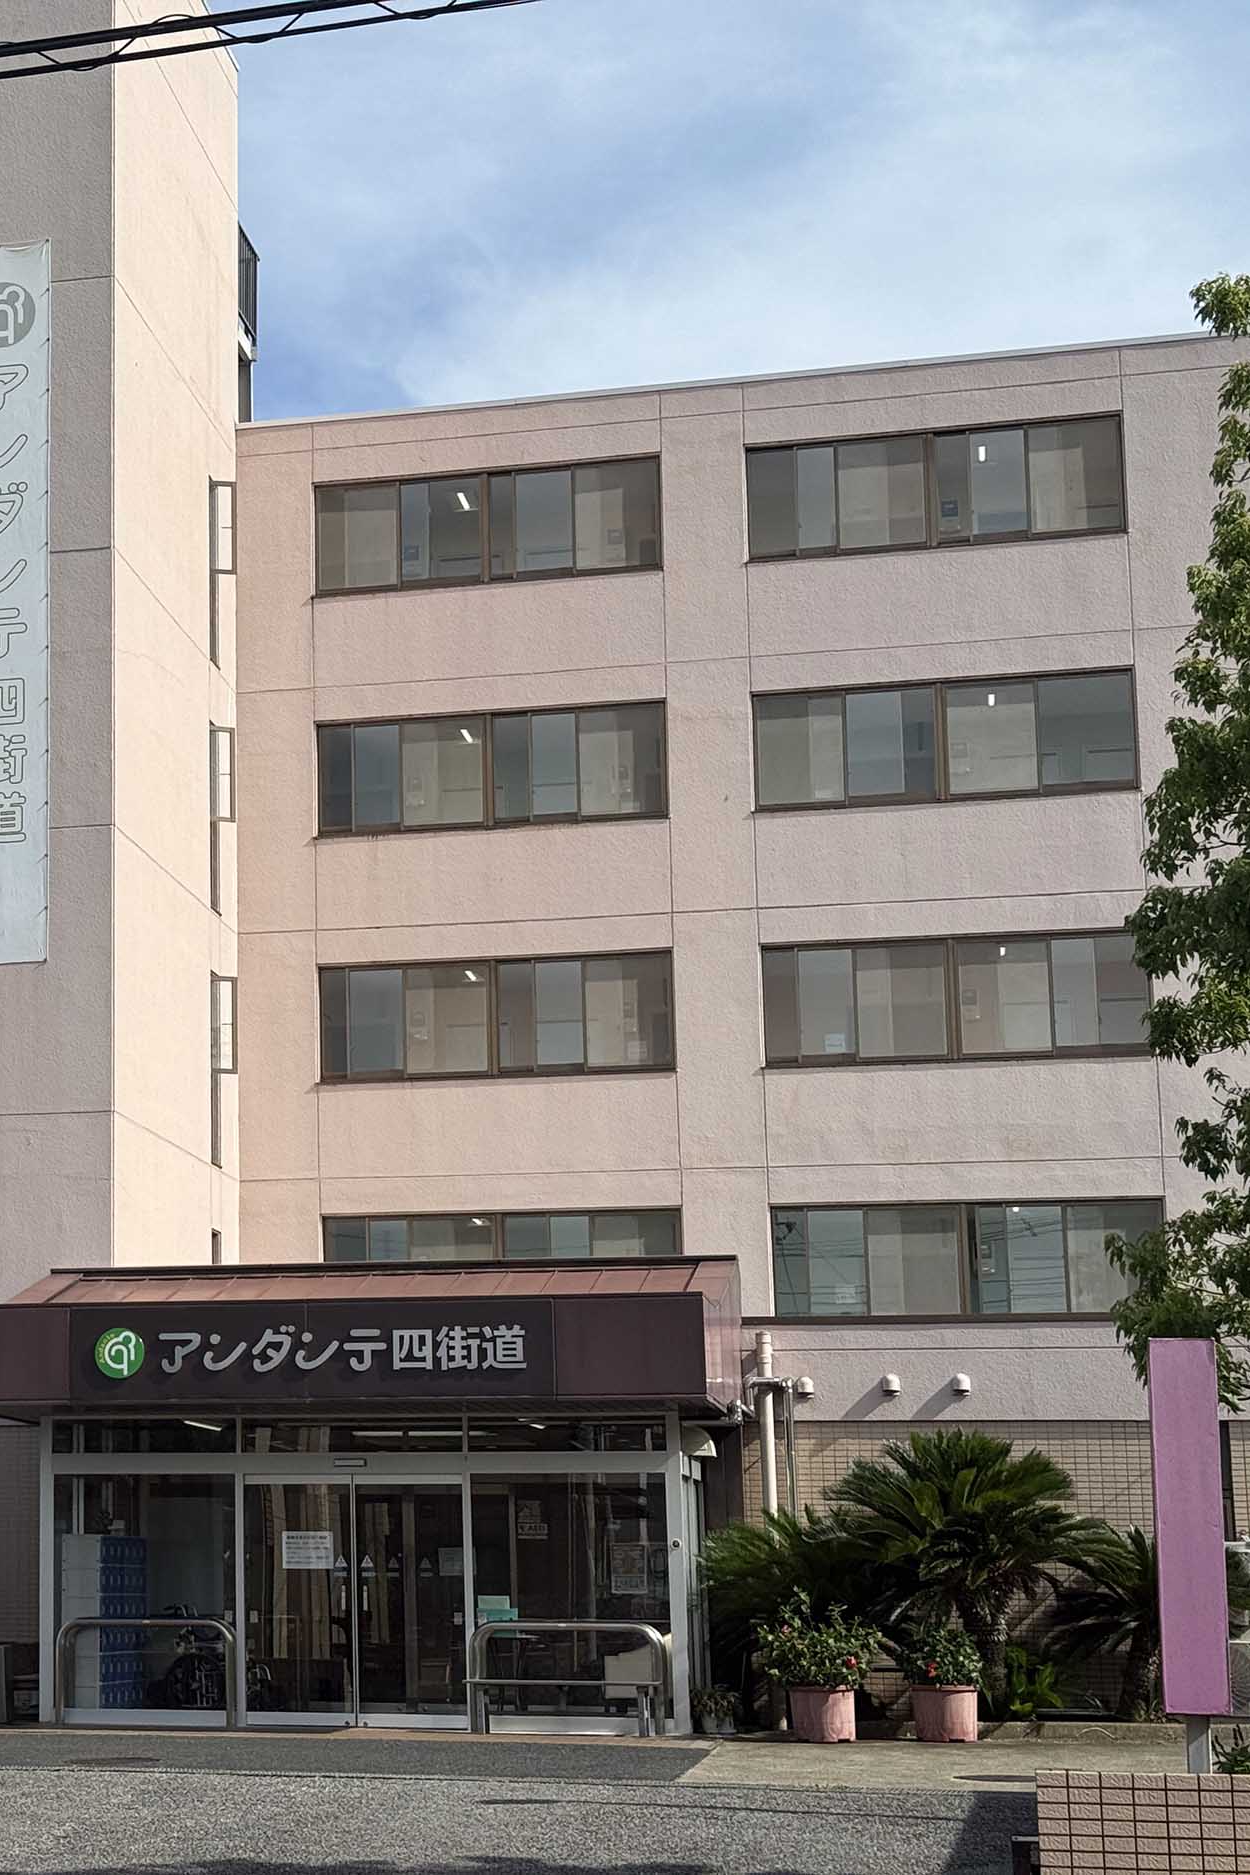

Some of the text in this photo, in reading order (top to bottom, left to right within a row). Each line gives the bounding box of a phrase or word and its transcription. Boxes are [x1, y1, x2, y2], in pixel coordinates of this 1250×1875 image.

[157, 1324, 528, 1374] アンダンテ四街道
